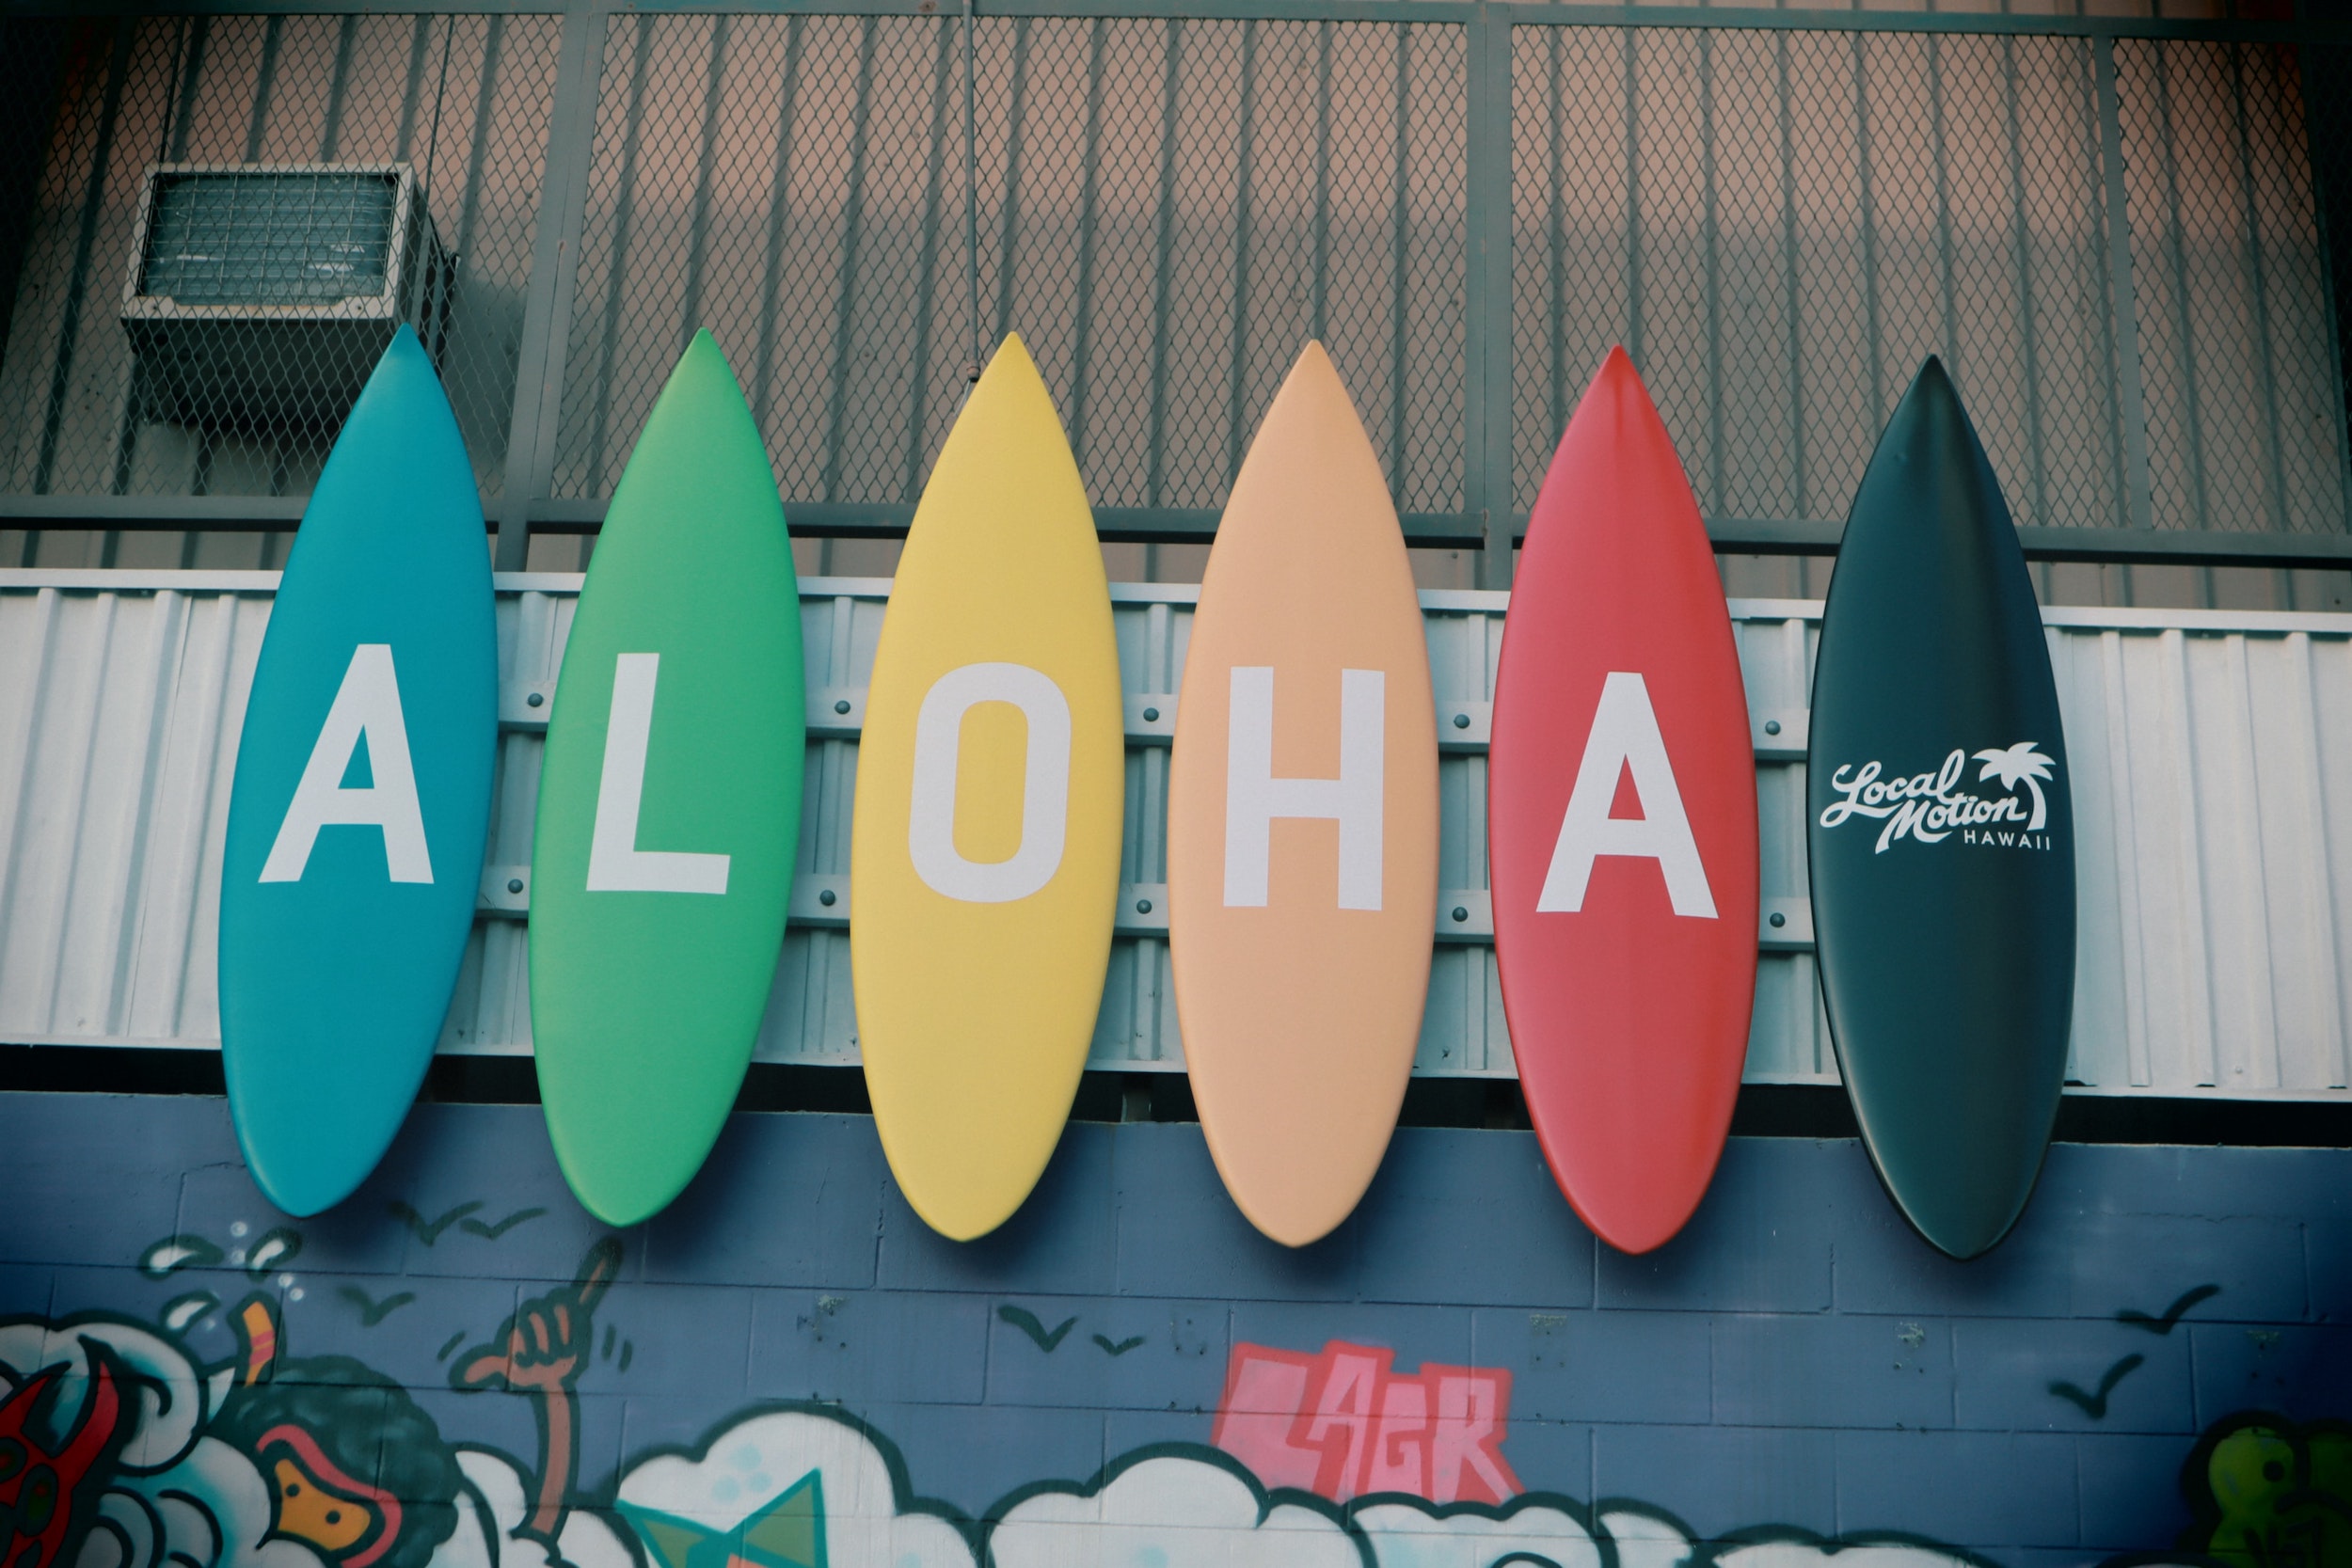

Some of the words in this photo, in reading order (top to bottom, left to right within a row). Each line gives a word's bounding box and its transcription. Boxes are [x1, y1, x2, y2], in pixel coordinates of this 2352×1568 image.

[258, 643, 1721, 920] ALOHA
[1820, 749, 1965, 828] Local
[1875, 792, 2027, 854] Motion
[1963, 830, 2050, 850] HAWAII
